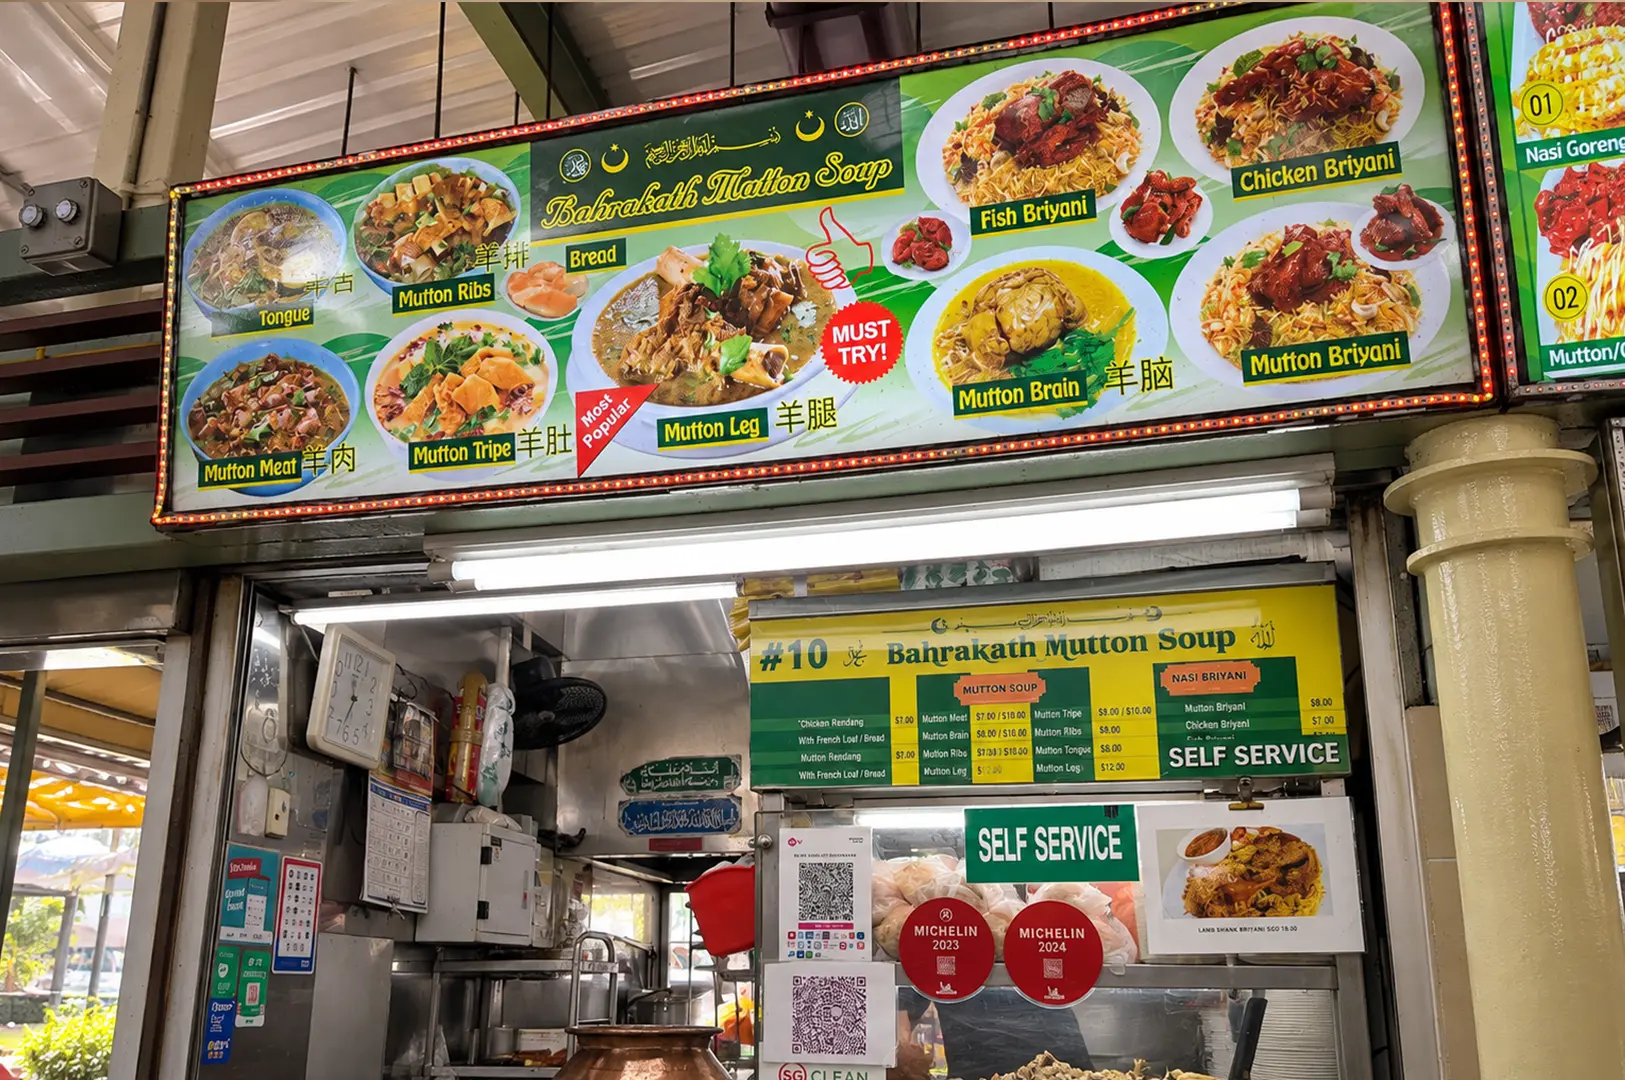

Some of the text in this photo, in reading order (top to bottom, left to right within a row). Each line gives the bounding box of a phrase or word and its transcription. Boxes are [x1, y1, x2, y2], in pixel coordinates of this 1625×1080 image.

[1529, 91, 1552, 117] 01
[1525, 142, 1562, 164] Nasi
[1239, 147, 1396, 193] Chicken Briyani
[540, 173, 702, 229] Bahrakath
[815, 151, 894, 191] Soup
[980, 194, 1089, 230] Fish Briyani
[569, 245, 617, 268] Bread
[398, 280, 492, 308] Mutton Ribs
[1552, 285, 1579, 311] 02
[259, 306, 310, 328] Tongue
[832, 319, 892, 344] MUST
[838, 342, 888, 366] TRY!
[1250, 336, 1402, 377] Mutton Briyani
[1104, 357, 1175, 396] 羊脑
[958, 376, 1081, 410] Mutton Brain
[579, 393, 614, 428] Most
[774, 396, 839, 434] 羊腿
[581, 396, 633, 449] Popular
[664, 416, 761, 443] Mutton Leg
[413, 439, 512, 466] Mutton Tripe
[517, 428, 573, 459] 羊肚
[204, 454, 297, 483] Mutton Meat
[301, 443, 356, 475] 羊肉
[759, 638, 828, 672] #10
[887, 634, 1037, 668] Bahrakath
[1044, 632, 1149, 661] Mutton
[1158, 627, 1236, 653] Soup
[1172, 671, 1247, 683] NASI BRIYANI
[962, 683, 1038, 695] MUTTON SOUP
[1126, 706, 1151, 715] $10.00
[1184, 702, 1246, 713] Mutton Briyani
[1310, 697, 1333, 707] $8.00
[831, 718, 864, 727] Rendang
[922, 714, 947, 724] Mutton
[1034, 709, 1082, 719] Mutton Tripe
[1186, 719, 1250, 731] Chicken Briyani
[816, 736, 840, 745] French
[922, 730, 969, 741] Mutton Brain
[1034, 728, 1061, 737] Mutton
[801, 753, 826, 762] Mutton
[1035, 745, 1062, 755] Mutton
[1168, 742, 1341, 768] SELF SERVICE
[817, 770, 842, 779] French
[924, 766, 951, 776] Mutton
[1036, 764, 1064, 773] Mutton
[978, 824, 1123, 863] SELF SERVICE
[914, 925, 978, 937] MICHELIN
[1019, 927, 1085, 939] MICHELIN
[932, 939, 960, 951] 2023
[1038, 941, 1067, 953] 2024
[783, 1070, 868, 1080] SG CLEAN
